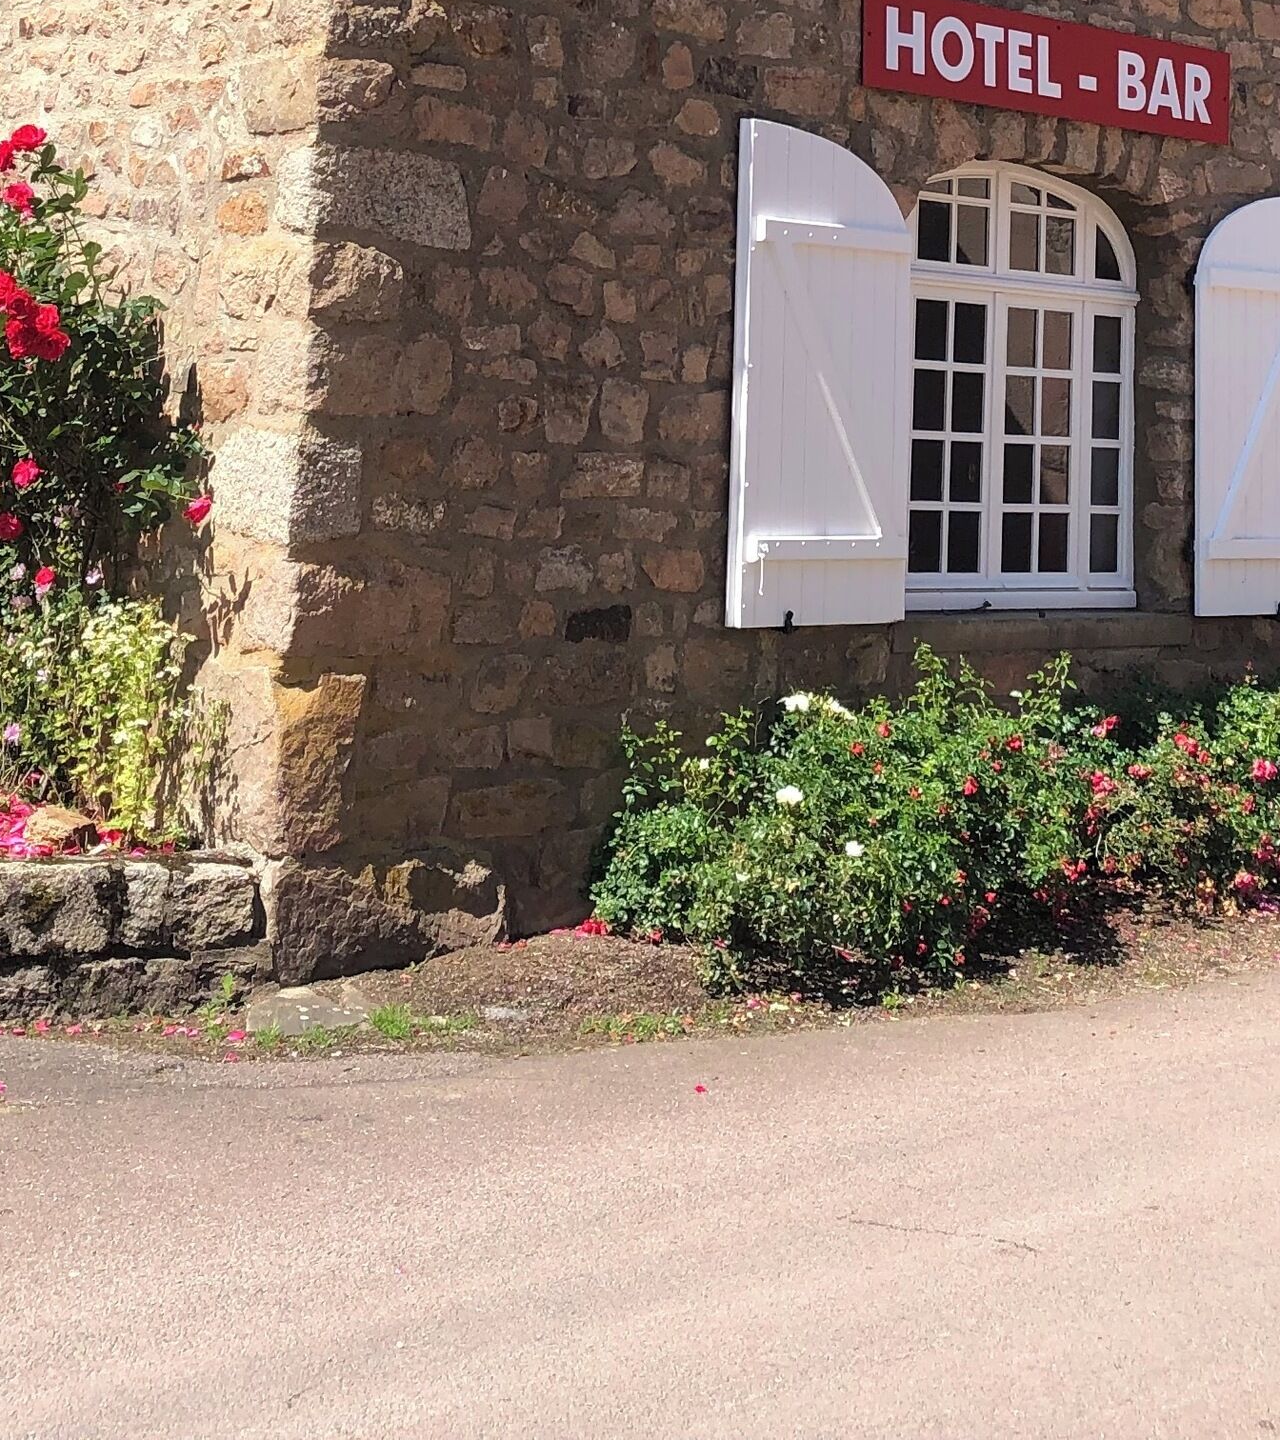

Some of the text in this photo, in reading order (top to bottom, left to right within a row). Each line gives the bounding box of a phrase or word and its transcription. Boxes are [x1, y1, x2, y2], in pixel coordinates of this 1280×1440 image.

[885, 5, 1212, 126] HOTEL - BAR
